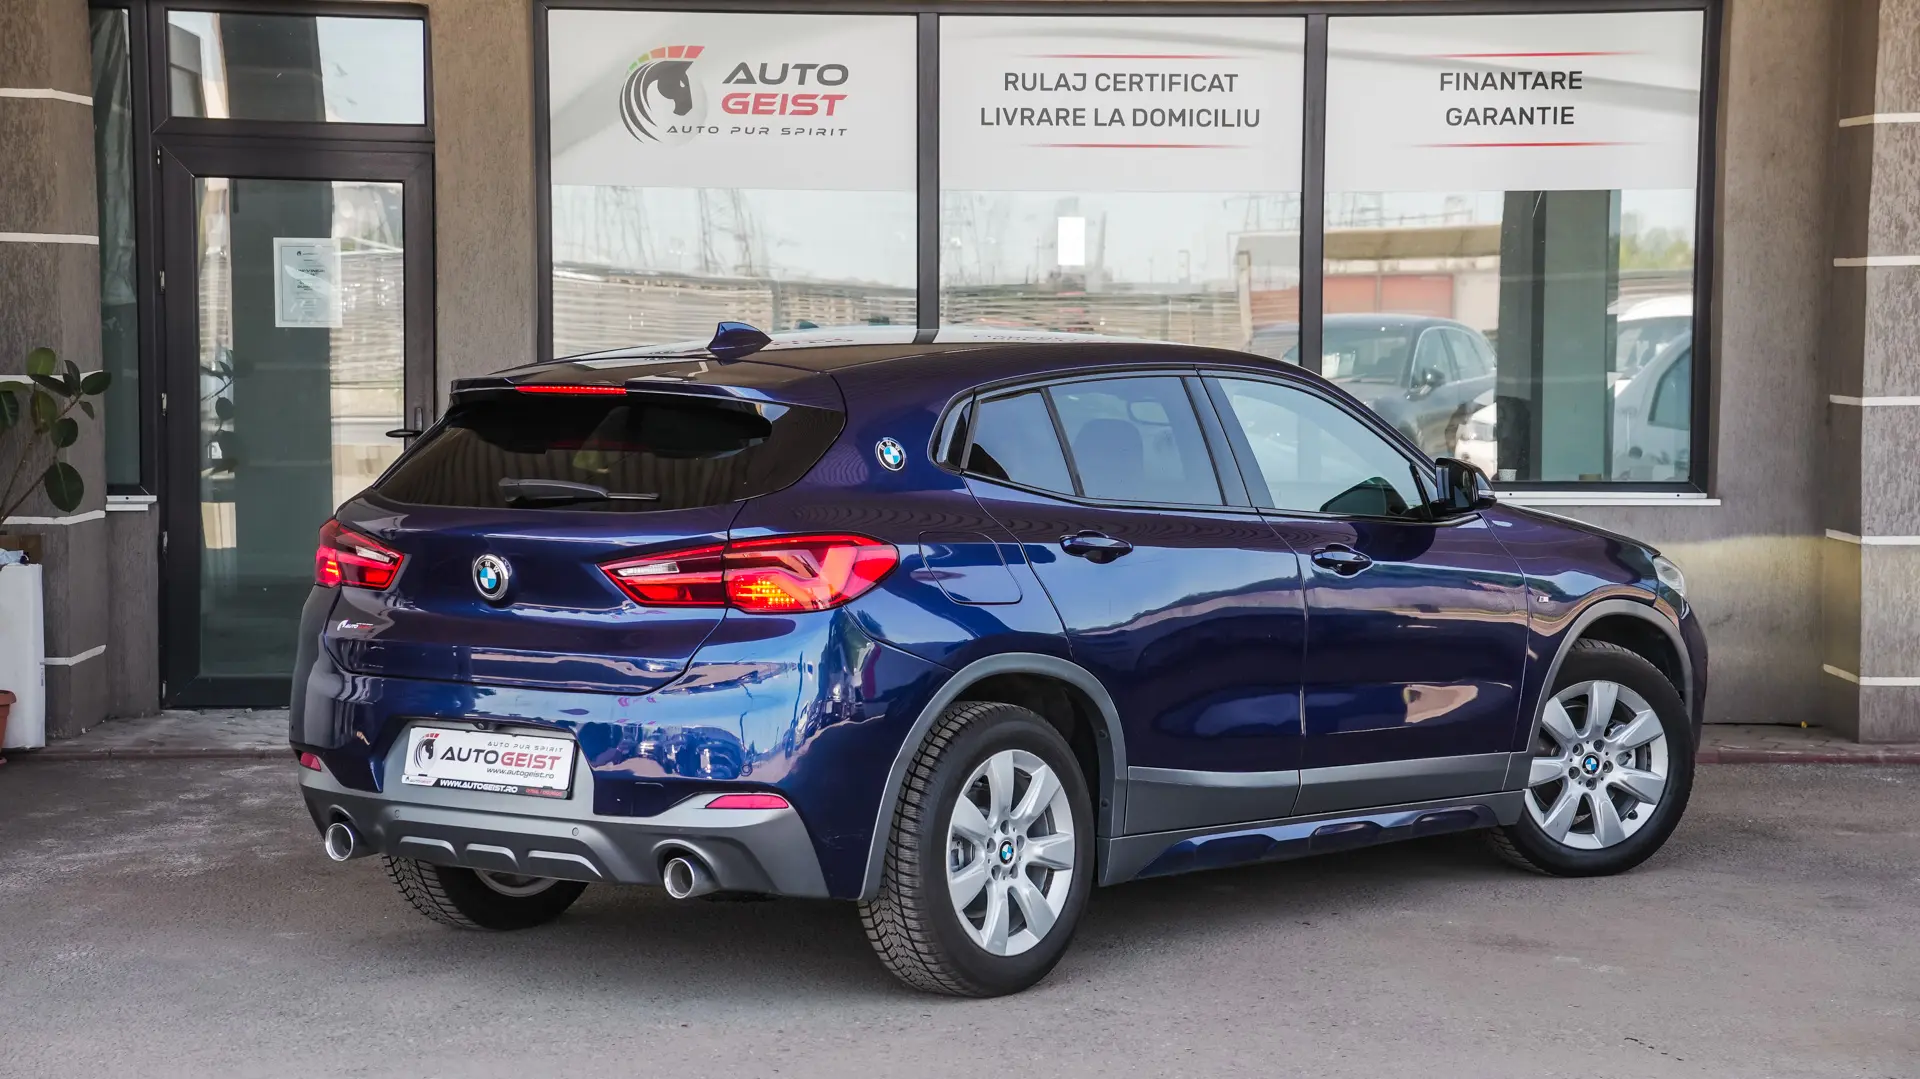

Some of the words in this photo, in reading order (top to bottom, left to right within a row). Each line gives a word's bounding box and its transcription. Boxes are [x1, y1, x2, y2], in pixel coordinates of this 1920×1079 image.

[722, 61, 849, 86] AUTO
[1004, 72, 1087, 91] RULAJ
[1094, 73, 1239, 92] CERTIFICAT
[1440, 70, 1583, 91] FINANTARE
[721, 92, 848, 116] GEIST
[980, 107, 1086, 127] LIVRARE
[1094, 108, 1126, 127] LA
[1132, 108, 1260, 128] DOMICILIU
[1445, 106, 1575, 126] GARANTIE
[666, 125, 719, 134] AUTO
[730, 126, 769, 135] PUR
[780, 127, 848, 137] SPIRIT
[534, 745, 563, 753] SPIRIT
[486, 767, 555, 779] www.autogeist.ro
[440, 778, 519, 793] WWW.AUTOGEIST.RO
